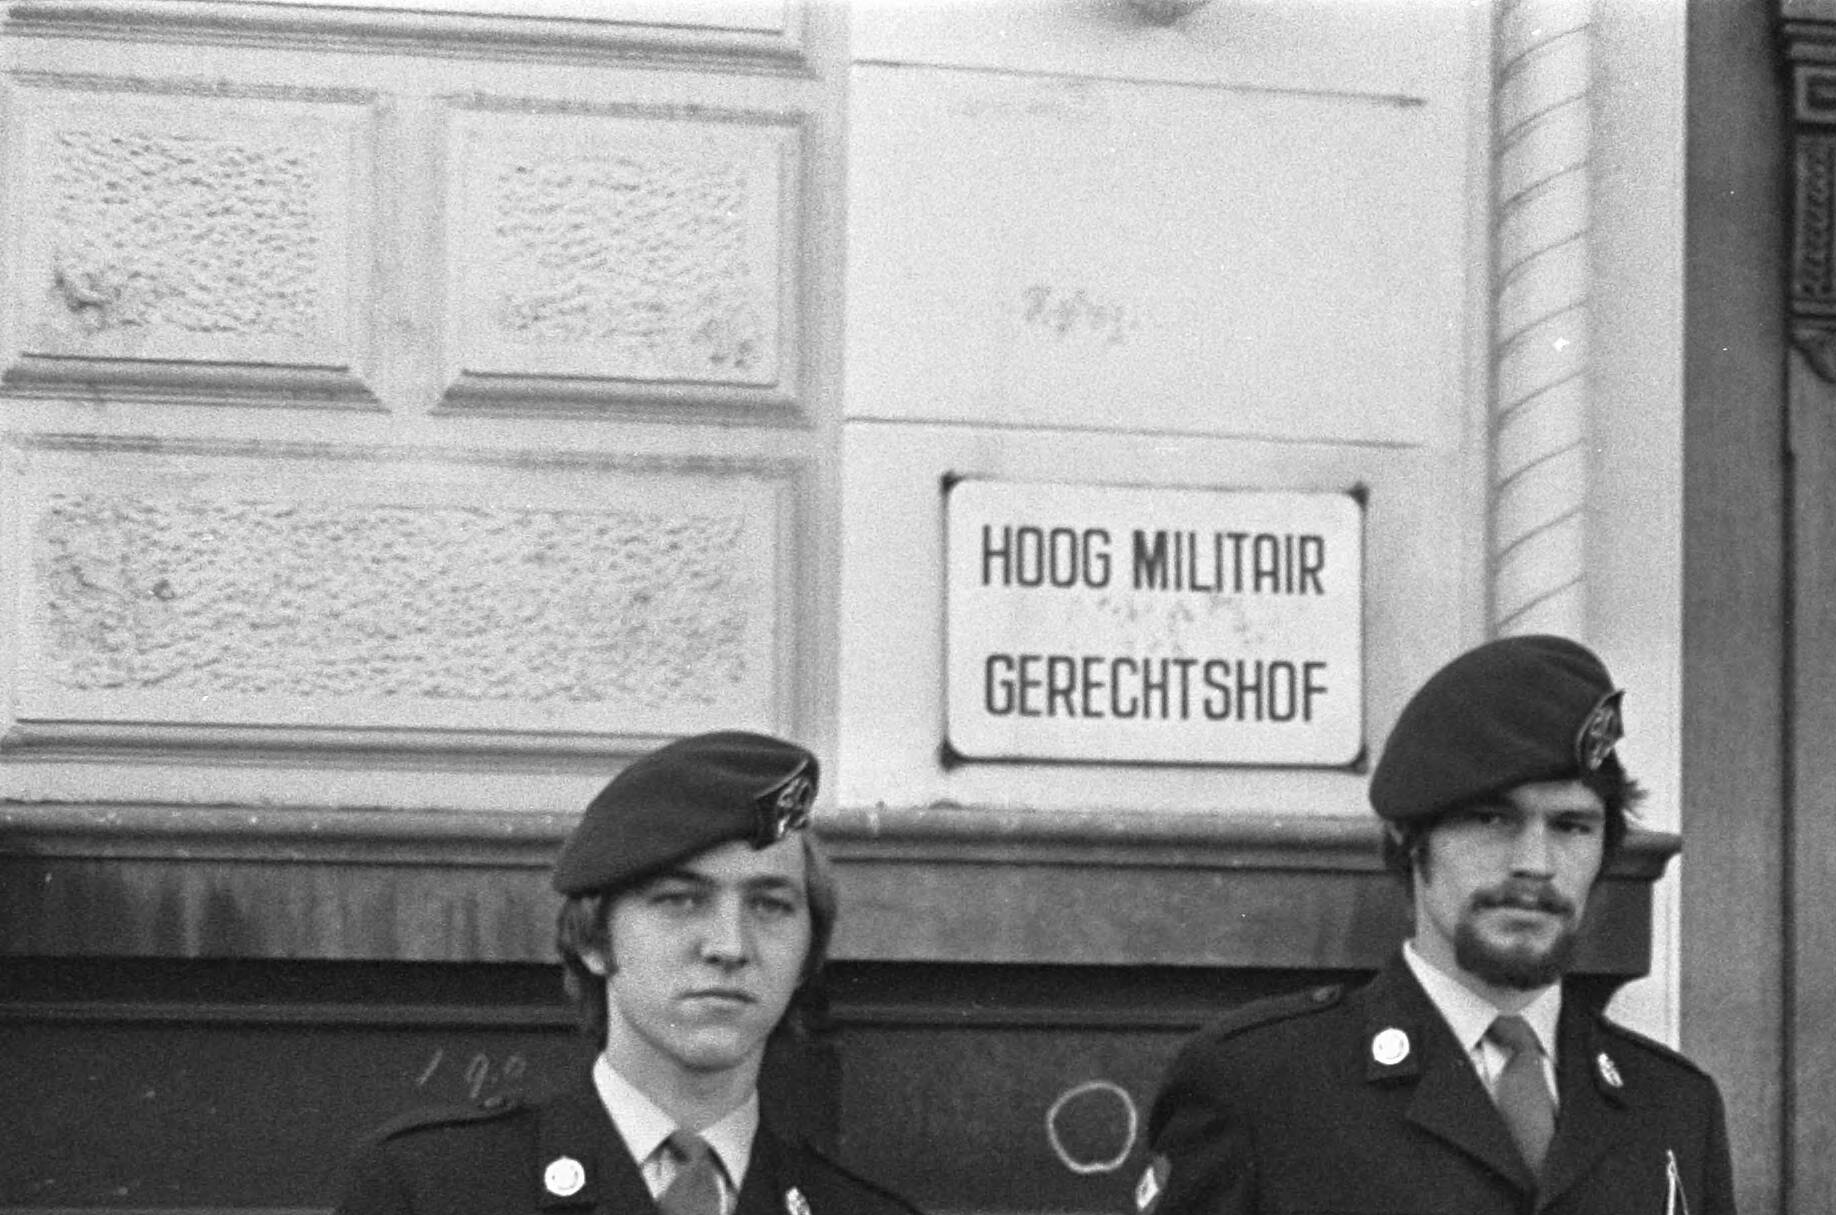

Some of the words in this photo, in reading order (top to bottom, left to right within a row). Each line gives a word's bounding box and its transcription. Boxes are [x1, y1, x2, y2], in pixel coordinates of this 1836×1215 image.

[982, 524, 1111, 589] HOOG
[1132, 529, 1325, 595] MILITAIR
[985, 653, 1328, 722] GERECHTSHOF
